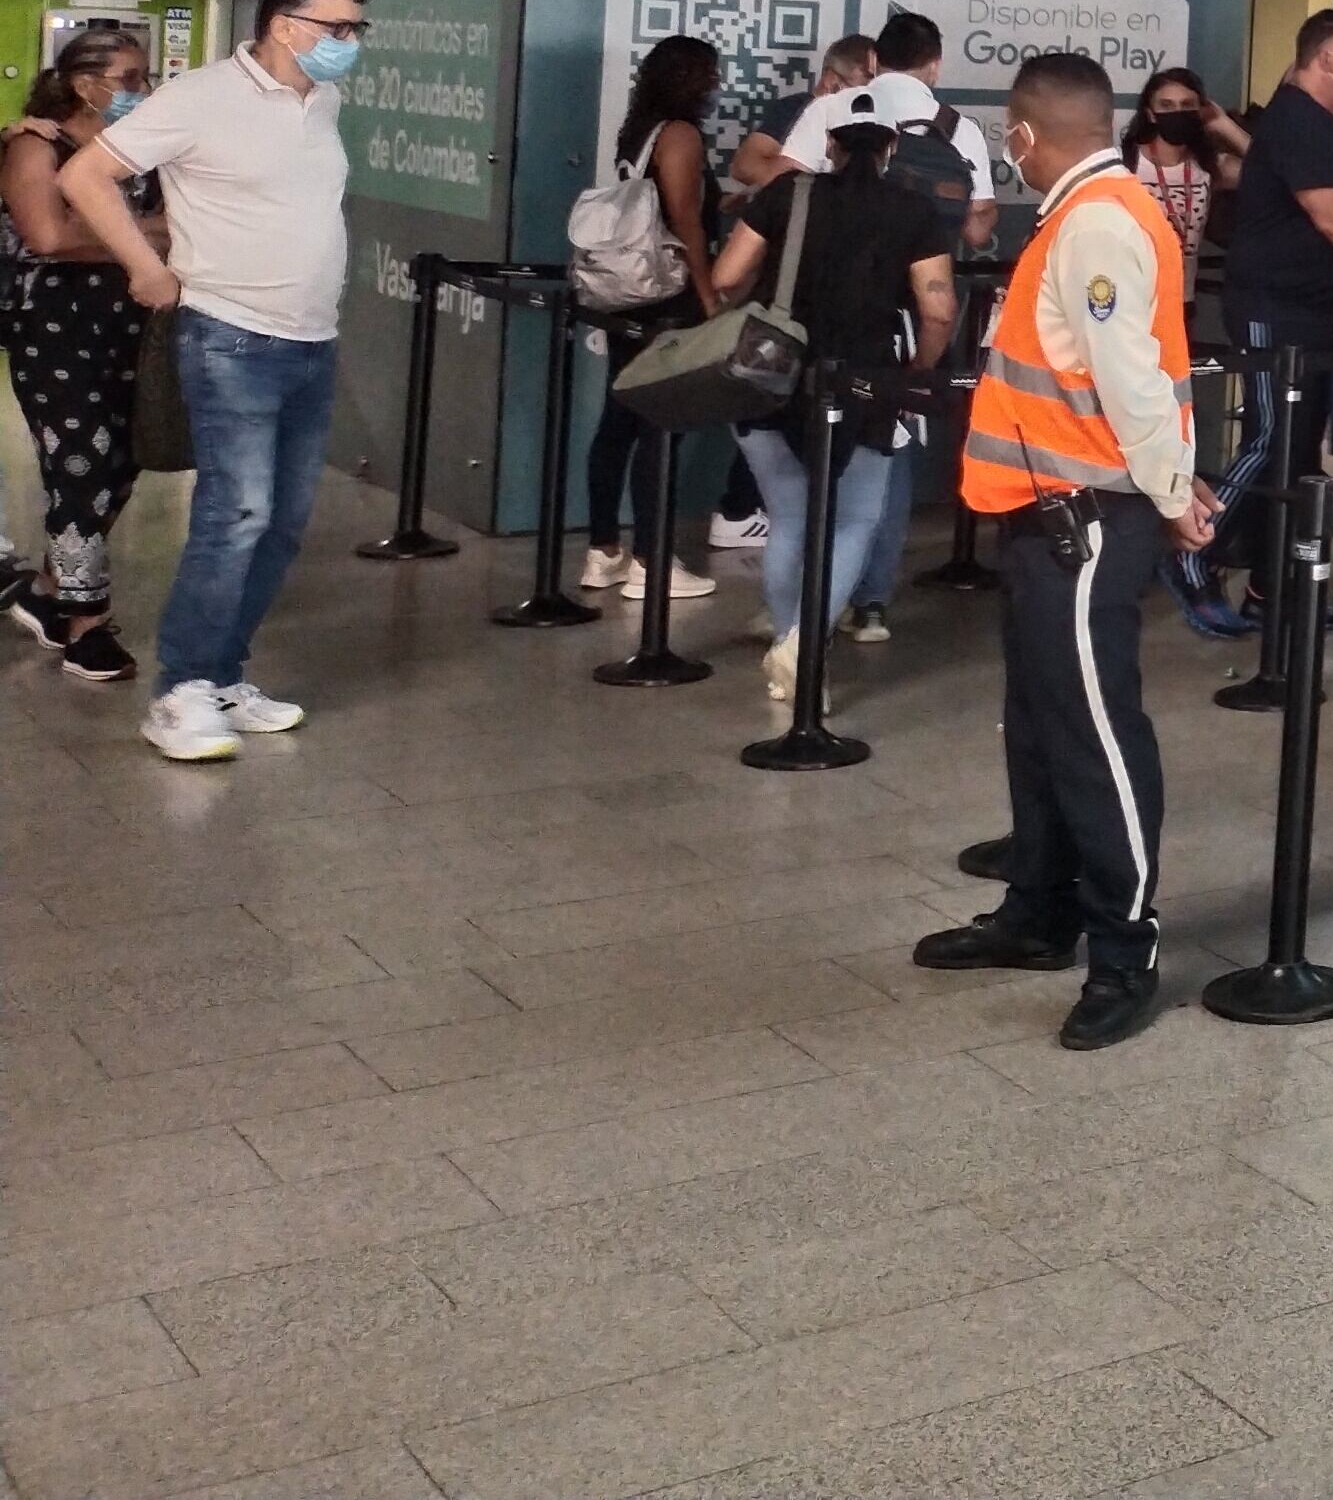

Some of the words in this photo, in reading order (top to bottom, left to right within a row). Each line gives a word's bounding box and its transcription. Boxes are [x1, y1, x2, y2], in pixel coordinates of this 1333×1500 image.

[168, 22, 190, 31] VISA
[467, 22, 488, 56] en
[1126, 12, 1161, 33] en
[1100, 36, 1166, 72] Play
[404, 69, 484, 122] ciudades
[369, 124, 389, 170] de
